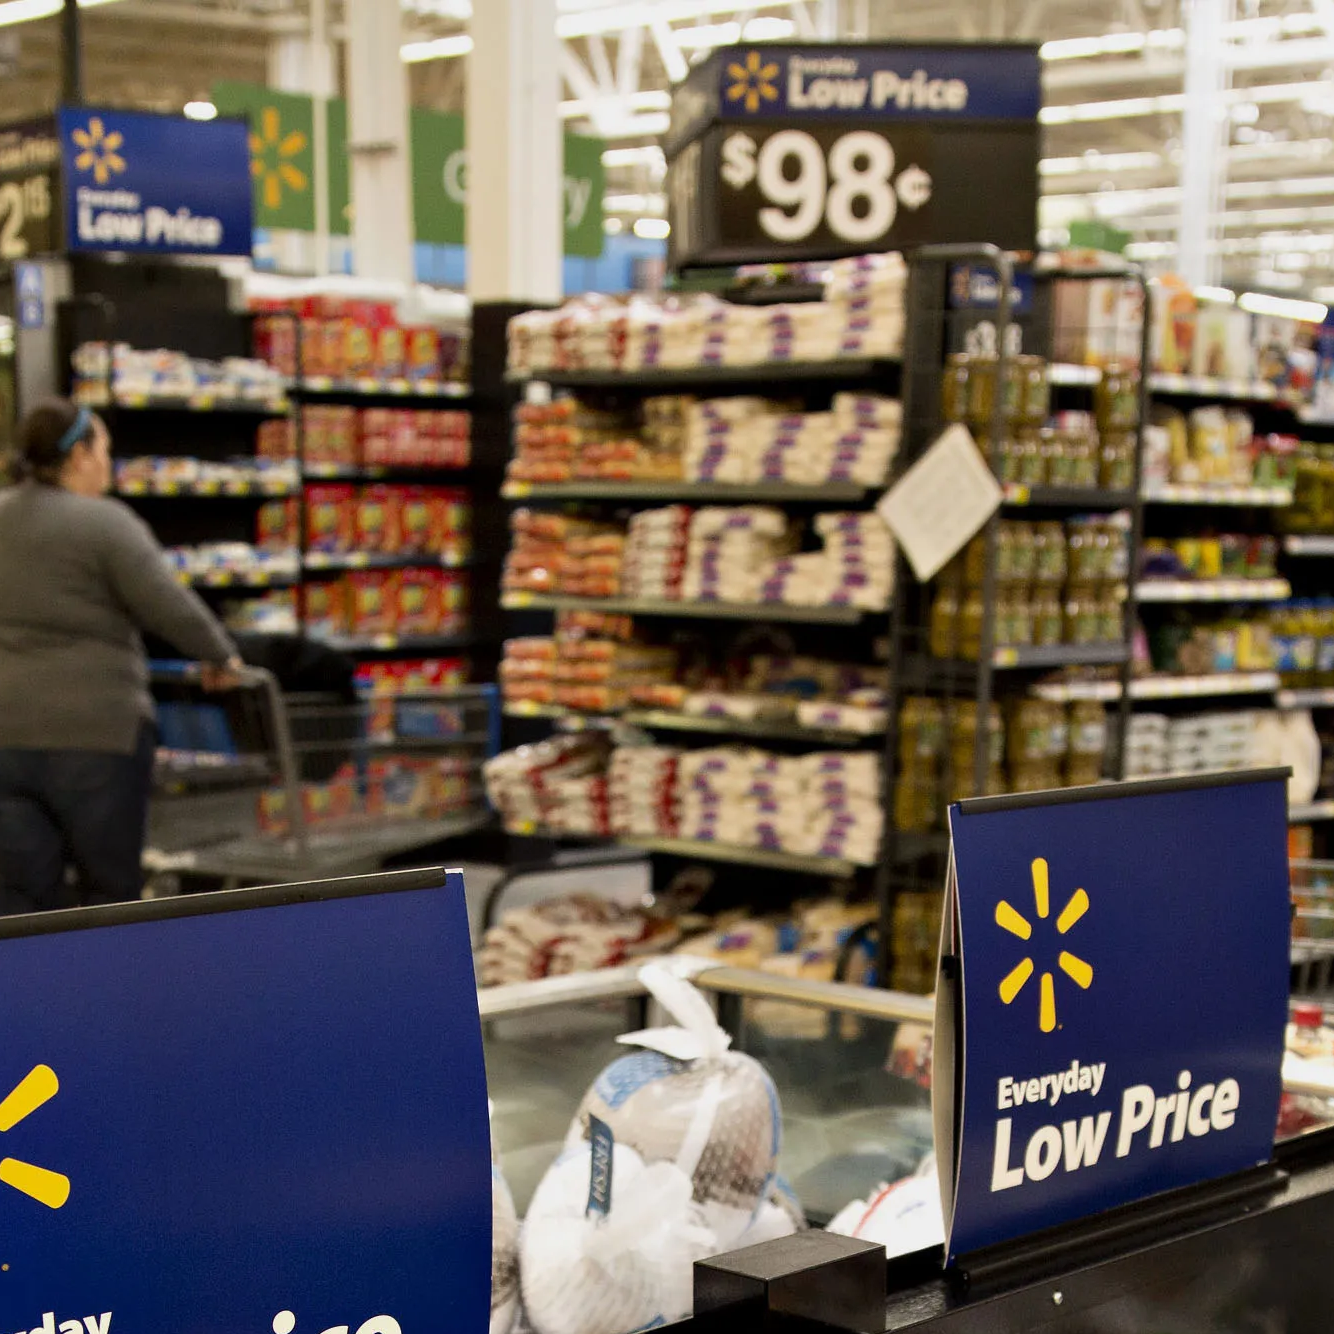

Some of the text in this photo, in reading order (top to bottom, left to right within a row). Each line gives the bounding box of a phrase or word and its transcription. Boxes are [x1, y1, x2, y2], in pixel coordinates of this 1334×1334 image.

[787, 69, 968, 110] Low Price
[78, 200, 222, 247] Low Price
[997, 1060, 1107, 1110] Everyday
[990, 1070, 1240, 1192] Low Price
